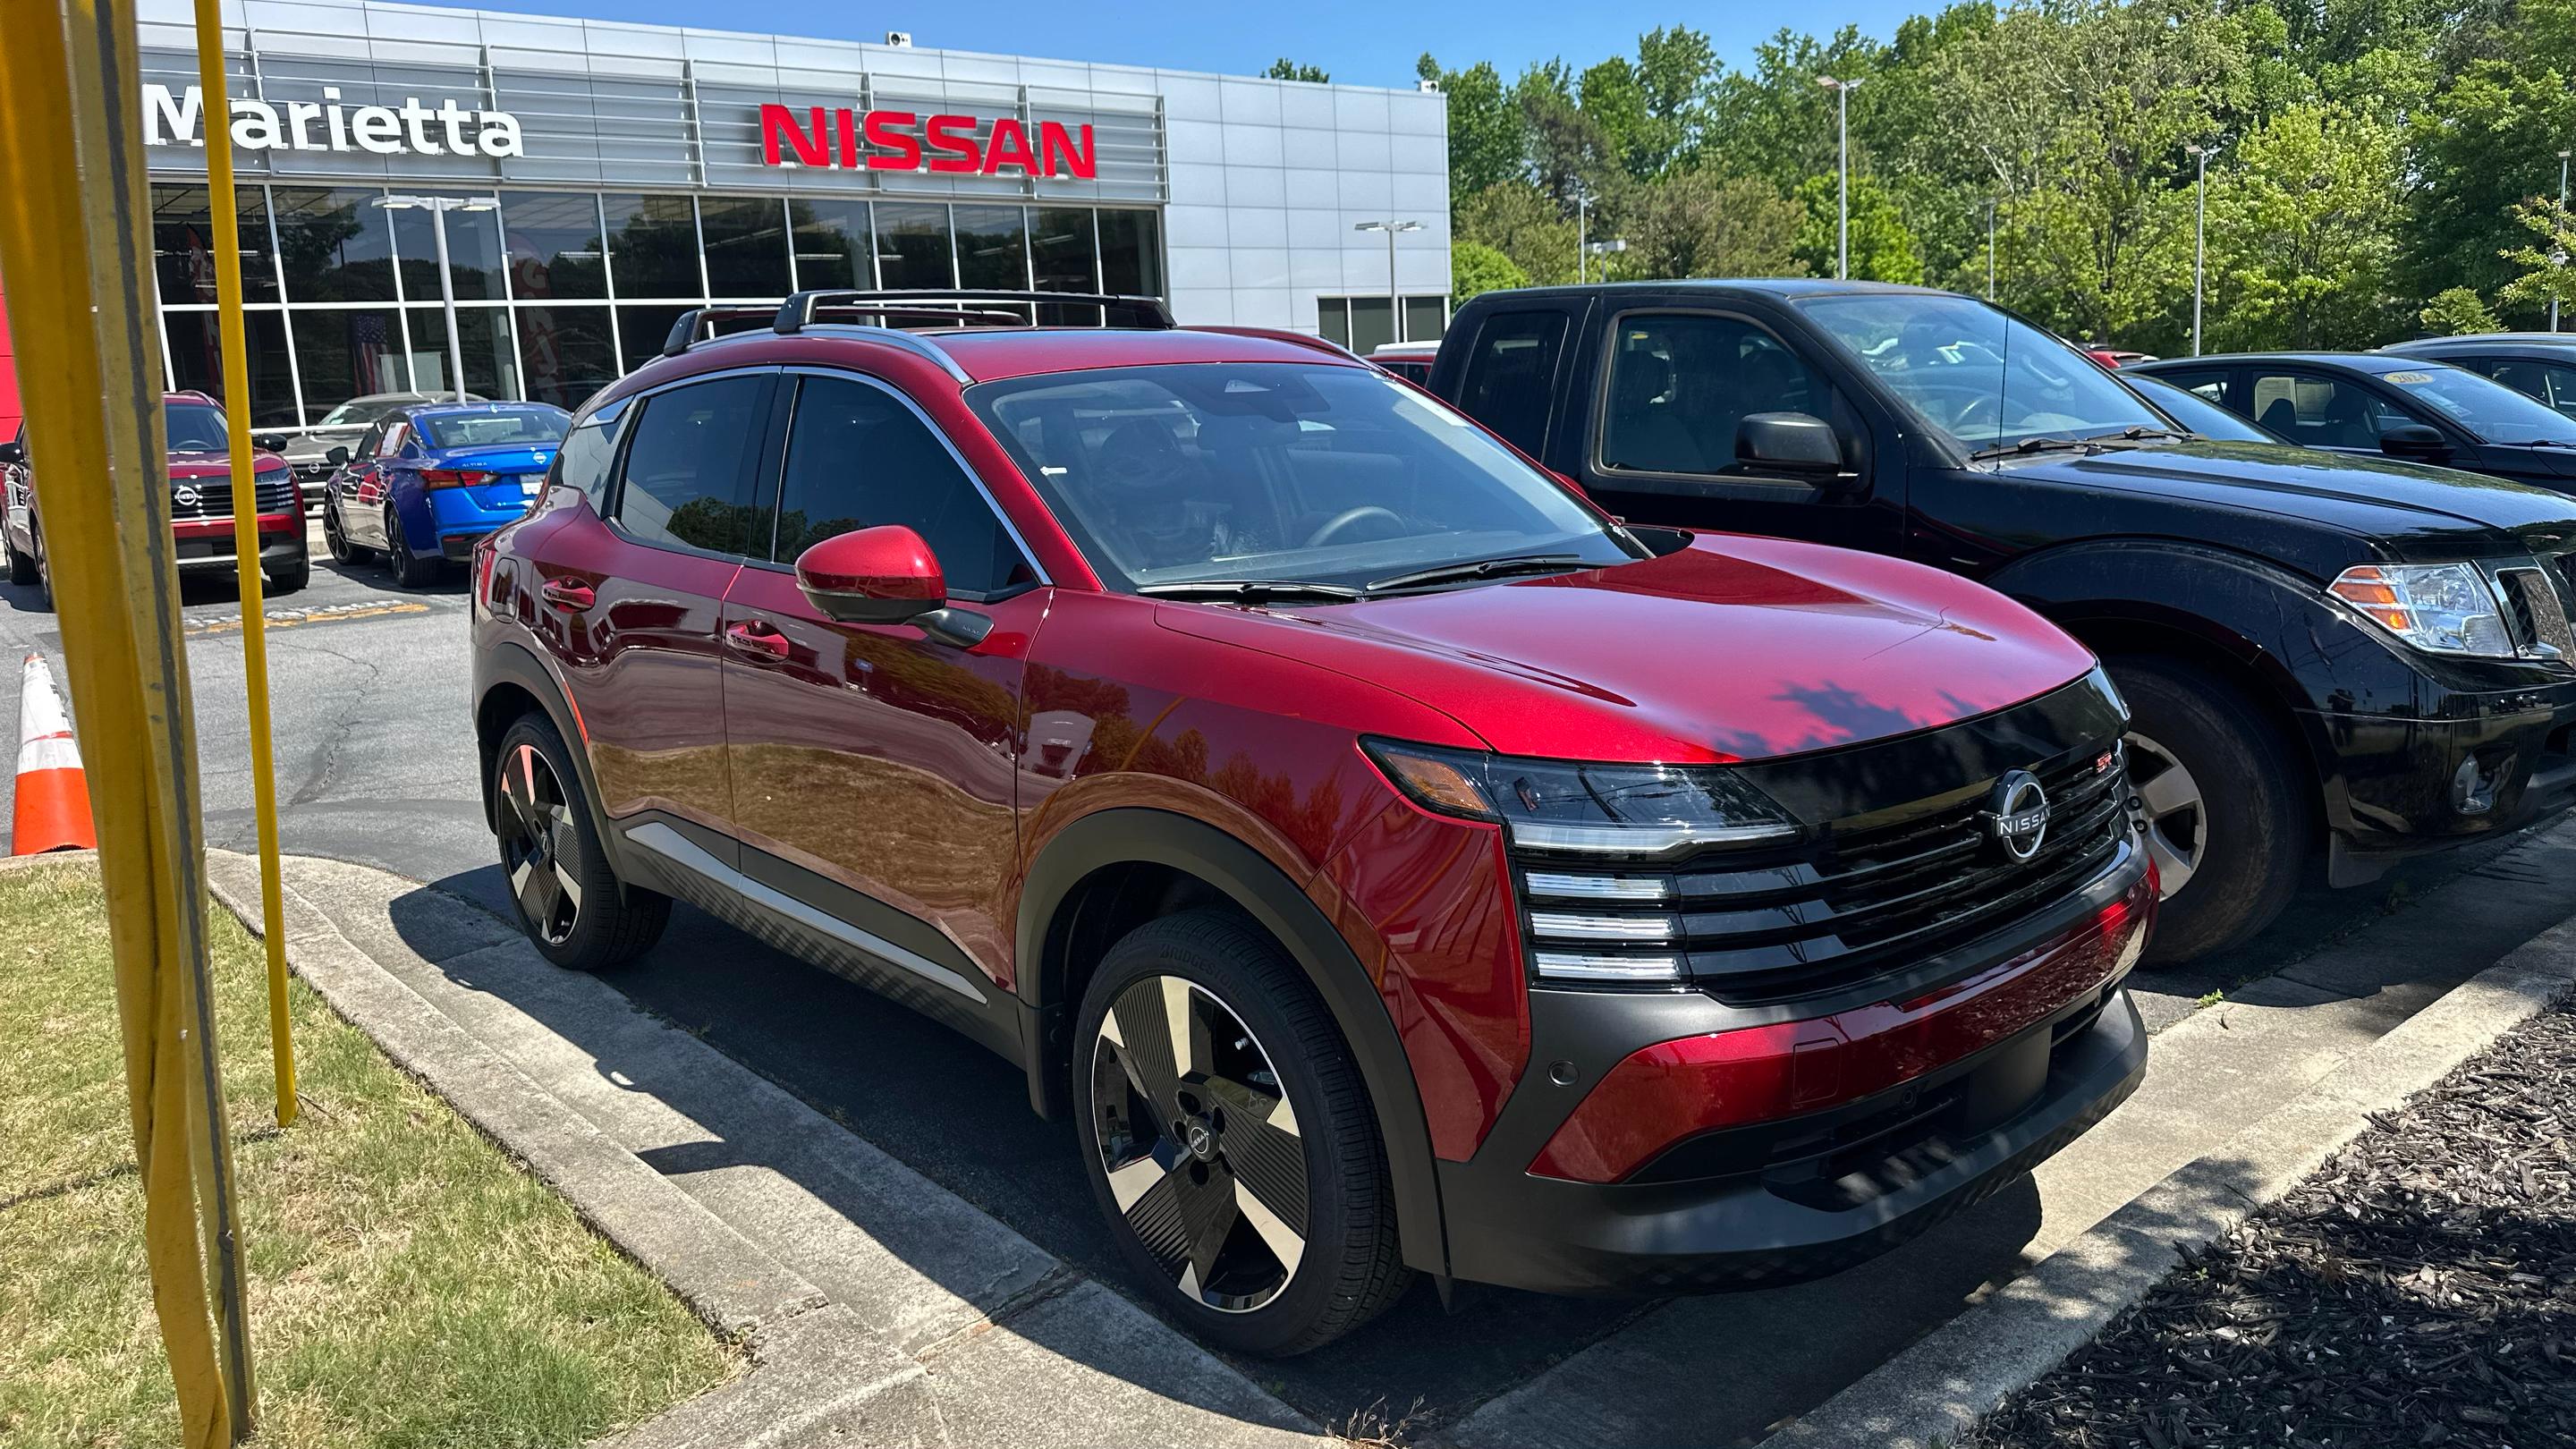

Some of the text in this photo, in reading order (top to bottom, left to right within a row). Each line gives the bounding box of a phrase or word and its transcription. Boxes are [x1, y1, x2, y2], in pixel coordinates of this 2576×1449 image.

[141, 84, 524, 157] Marietta
[759, 103, 1097, 180] NISSAN
[2000, 807, 2050, 835] NISSAN
